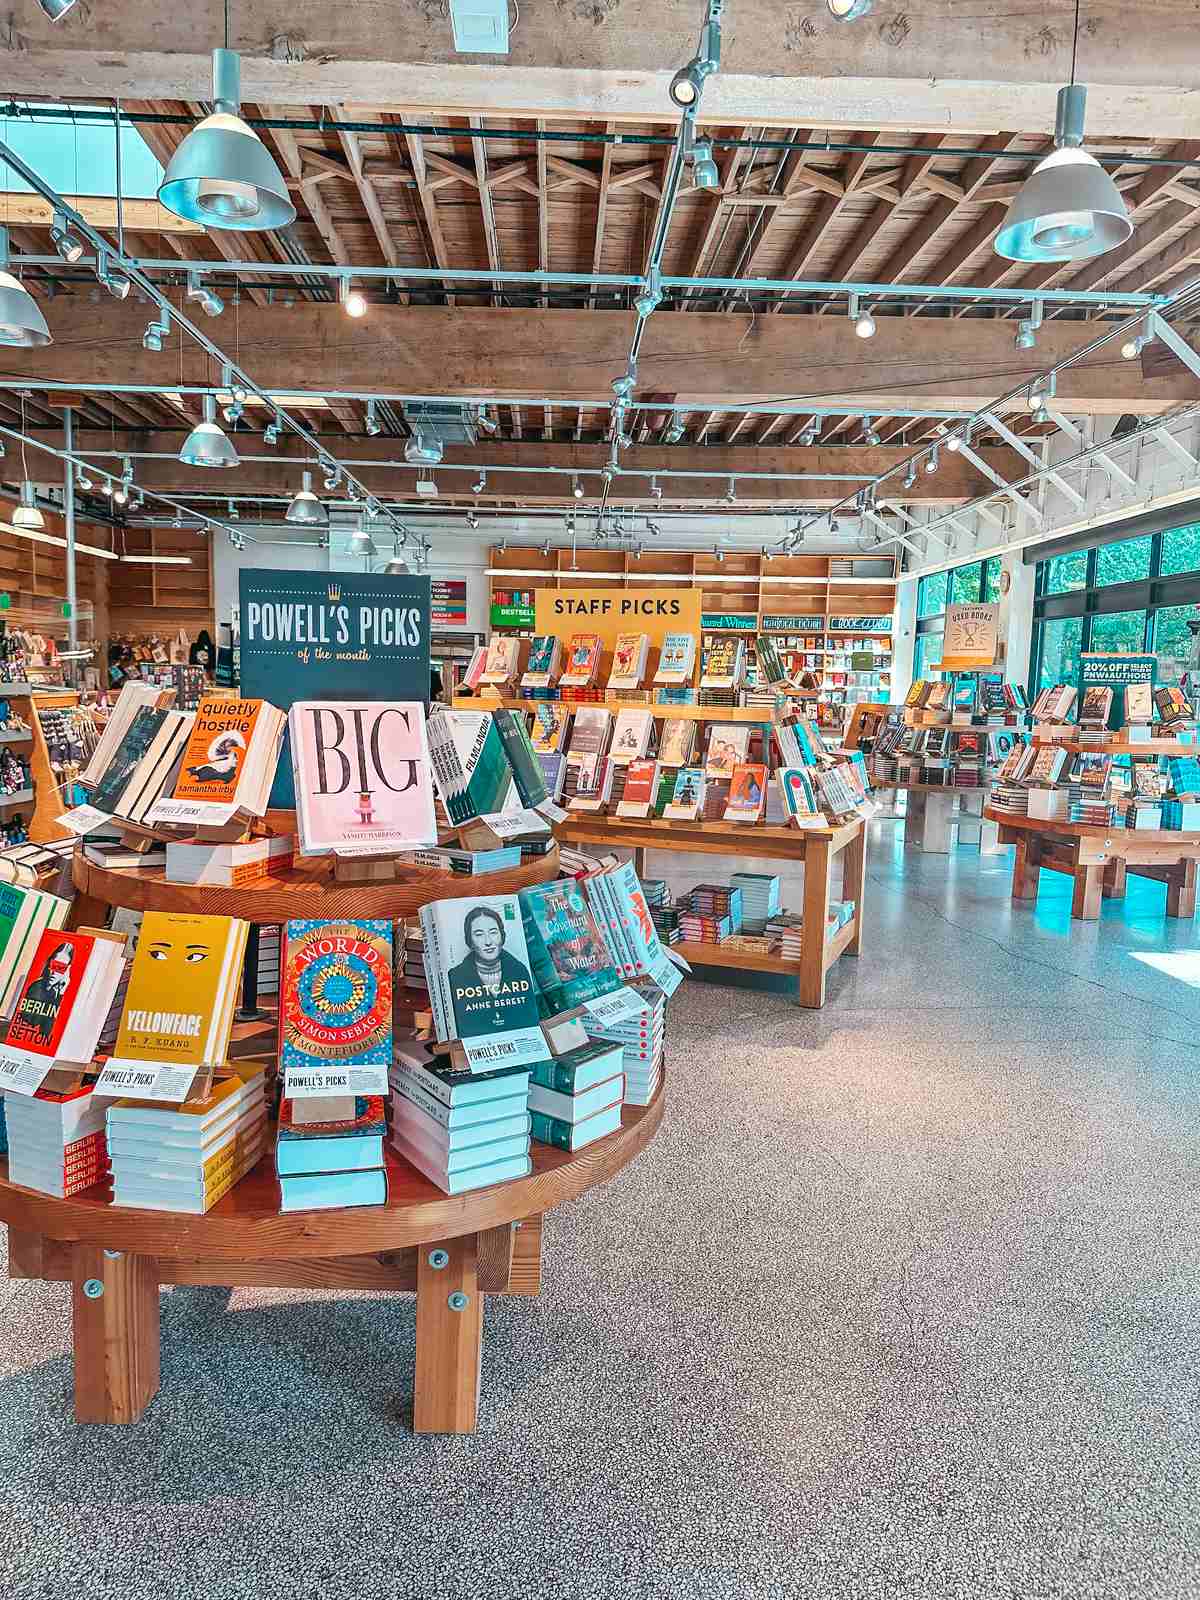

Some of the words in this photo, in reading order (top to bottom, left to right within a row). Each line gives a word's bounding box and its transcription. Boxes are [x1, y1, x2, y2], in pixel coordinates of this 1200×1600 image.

[555, 599, 612, 614] STAFF
[621, 599, 680, 614] PICKS
[248, 603, 349, 644] POWELL'S
[360, 606, 421, 647] PICKS
[952, 612, 969, 622] USED
[970, 611, 993, 621] BOOKS
[297, 647, 310, 664] of
[315, 647, 332, 660] the
[336, 649, 372, 661] month
[1084, 663, 1107, 672] 20%
[1109, 663, 1129, 672] OFF
[202, 701, 257, 717] quietly
[196, 718, 250, 732] hostile
[304, 708, 421, 795] BIG
[177, 783, 217, 793] samantha
[552, 899, 569, 912] The
[299, 938, 379, 963] WORLD
[571, 935, 581, 950] of
[569, 954, 597, 970] Water
[456, 980, 529, 1000] POSTCARD
[19, 998, 61, 1018] BERLIN
[465, 1001, 491, 1012] ANNE
[494, 996, 526, 1008] BEREST
[127, 1010, 203, 1037] YELLOWFACE
[297, 1018, 337, 1041] SIMON
[341, 1016, 377, 1038] SEBAG
[9, 1025, 54, 1047] SETTON
[156, 1038, 190, 1048] KUANG
[300, 1036, 378, 1056] MONTEFIORE
[468, 1043, 498, 1061] POWELL'S
[5, 1059, 20, 1075] PICKS
[101, 1069, 134, 1084] POWELL'S
[133, 1072, 155, 1085] PICKS
[288, 1076, 323, 1087] POWELL'S
[325, 1076, 347, 1086] PICKS
[65, 1135, 97, 1154] BERLIN
[66, 1146, 97, 1165] BERLIN
[66, 1155, 97, 1175] BERLIN
[66, 1166, 97, 1185] BERLIN
